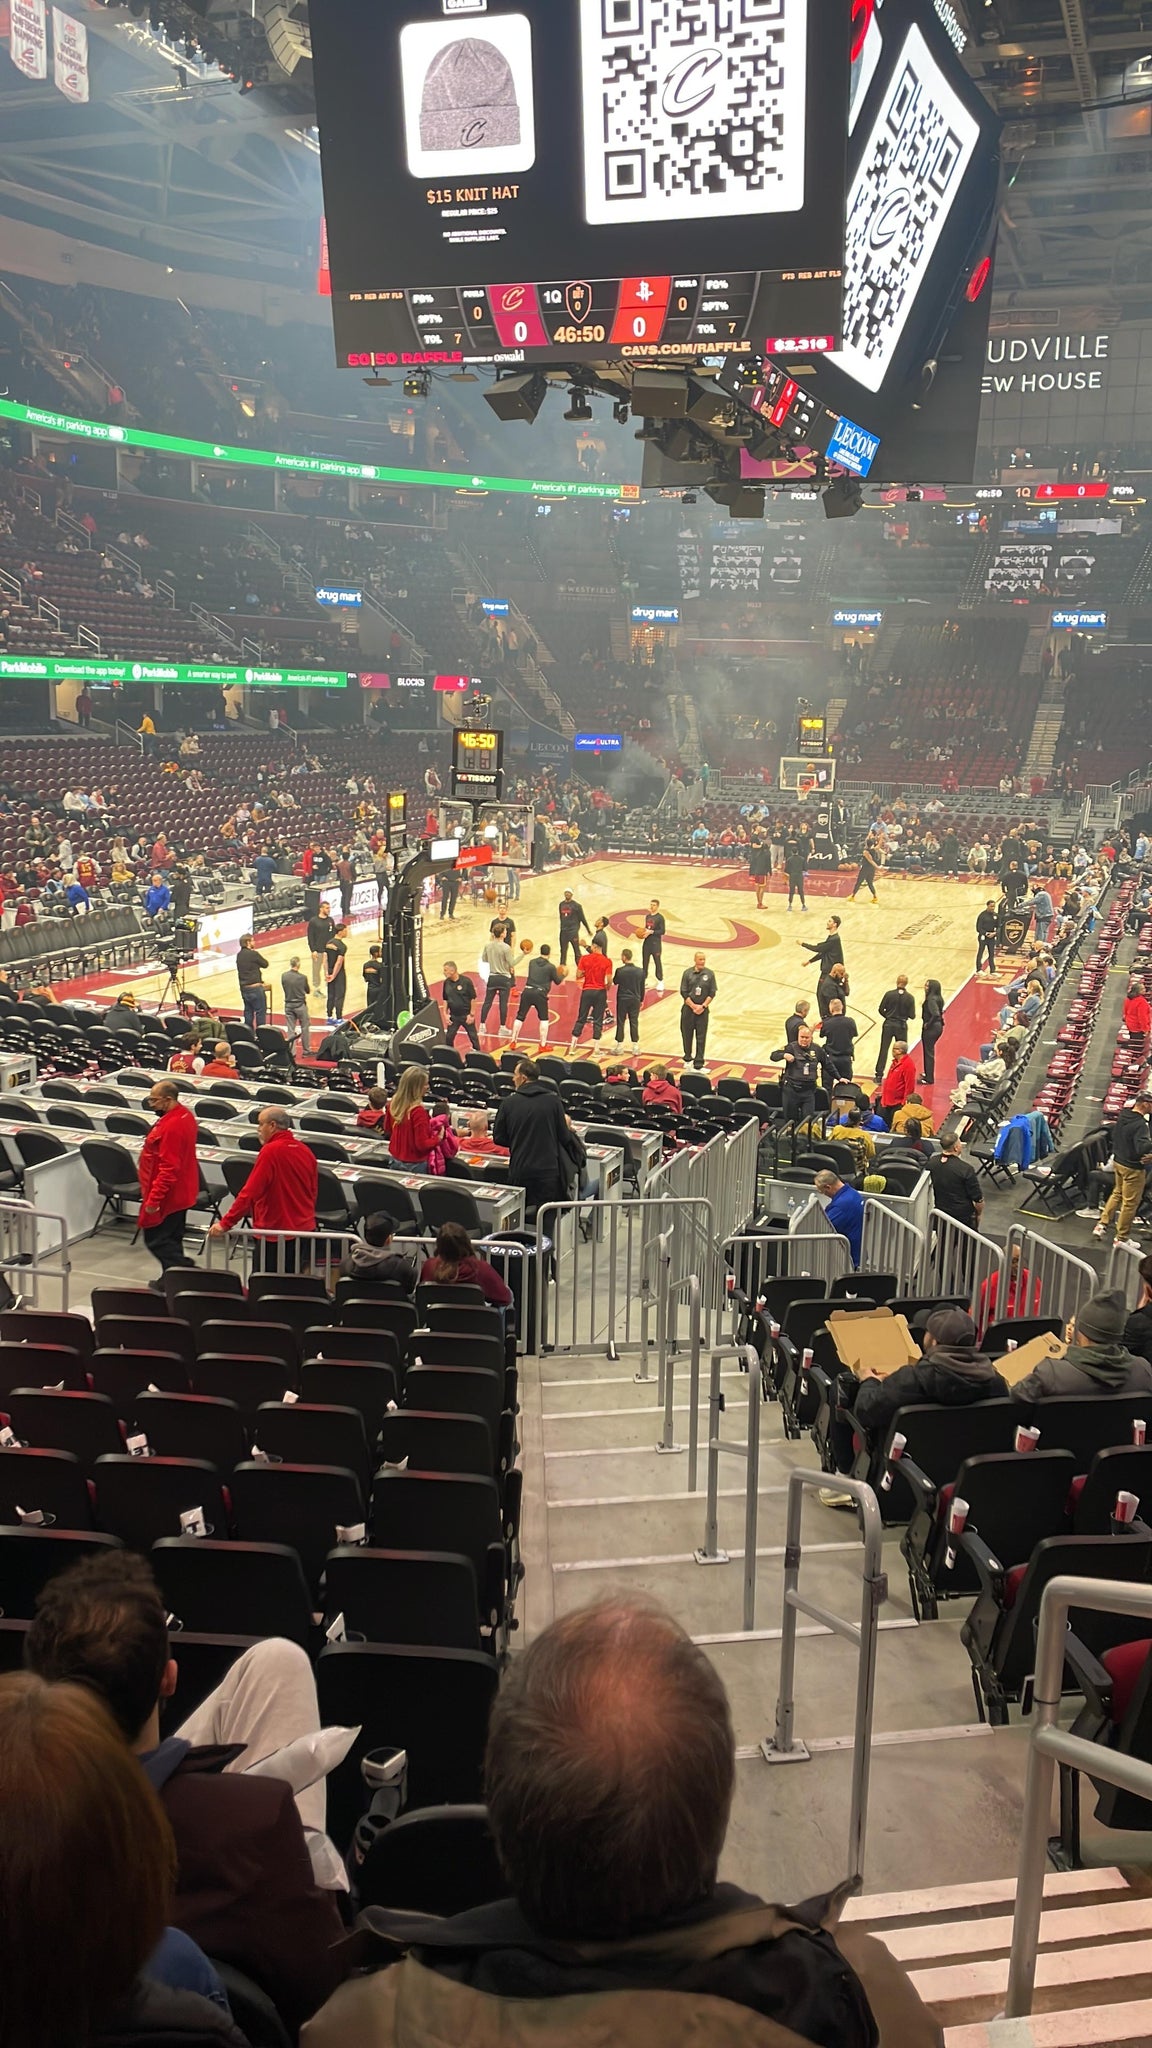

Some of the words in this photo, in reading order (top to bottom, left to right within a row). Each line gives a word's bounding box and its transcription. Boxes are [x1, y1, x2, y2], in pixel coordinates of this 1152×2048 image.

[426, 189, 452, 205] $15
[455, 187, 489, 202] KNIT
[492, 185, 520, 200] HAT
[813, 270, 828, 278] AST
[706, 279, 729, 290] FG%
[543, 289, 562, 304] 1Q
[678, 297, 688, 311] 0
[473, 306, 483, 320] 0
[514, 321, 528, 343] 0
[632, 316, 647, 338] 0
[697, 324, 717, 334] TOL
[728, 322, 737, 334] 7
[423, 334, 443, 344] TOL
[454, 334, 462, 344] 7
[553, 325, 605, 344] 46:50
[621, 341, 752, 356] CAVS.COM/RAFFLE
[773, 338, 828, 352] $2,316
[988, 335, 1109, 363] UDVILLE
[401, 351, 463, 364] RAFFLE
[493, 349, 525, 362] oswald
[1021, 371, 1103, 392] HOUSE
[26, 409, 56, 426] America's
[66, 421, 92, 436] parking
[93, 427, 108, 438] app
[275, 456, 310, 469] America's
[320, 462, 346, 475] parking
[347, 466, 360, 475] app
[531, 482, 566, 493] America's
[578, 485, 605, 496] parking
[605, 488, 620, 497] app
[791, 492, 817, 500] FOULS
[975, 488, 1003, 498] 46:50
[1015, 487, 1031, 498] 1Q
[1077, 486, 1085, 496] 0
[316, 589, 338, 603] drug
[339, 592, 362, 603] mart
[632, 607, 655, 619] drug
[656, 608, 679, 618] mart
[834, 611, 857, 624] drug
[858, 611, 882, 622] mart
[1052, 612, 1079, 625] drug
[1080, 612, 1107, 623] mart
[1, 661, 47, 674] ParkMobile
[54, 664, 85, 674] Download
[86, 665, 95, 675] the
[95, 667, 107, 676] app
[142, 667, 178, 678] ParkMobile
[253, 671, 282, 682] ParkMobile
[397, 678, 425, 686] BLOCKS
[460, 732, 496, 749] 46:50
[530, 743, 569, 753] LECOM
[467, 774, 497, 783] TISSOT
[416, 972, 427, 998] Clinic
